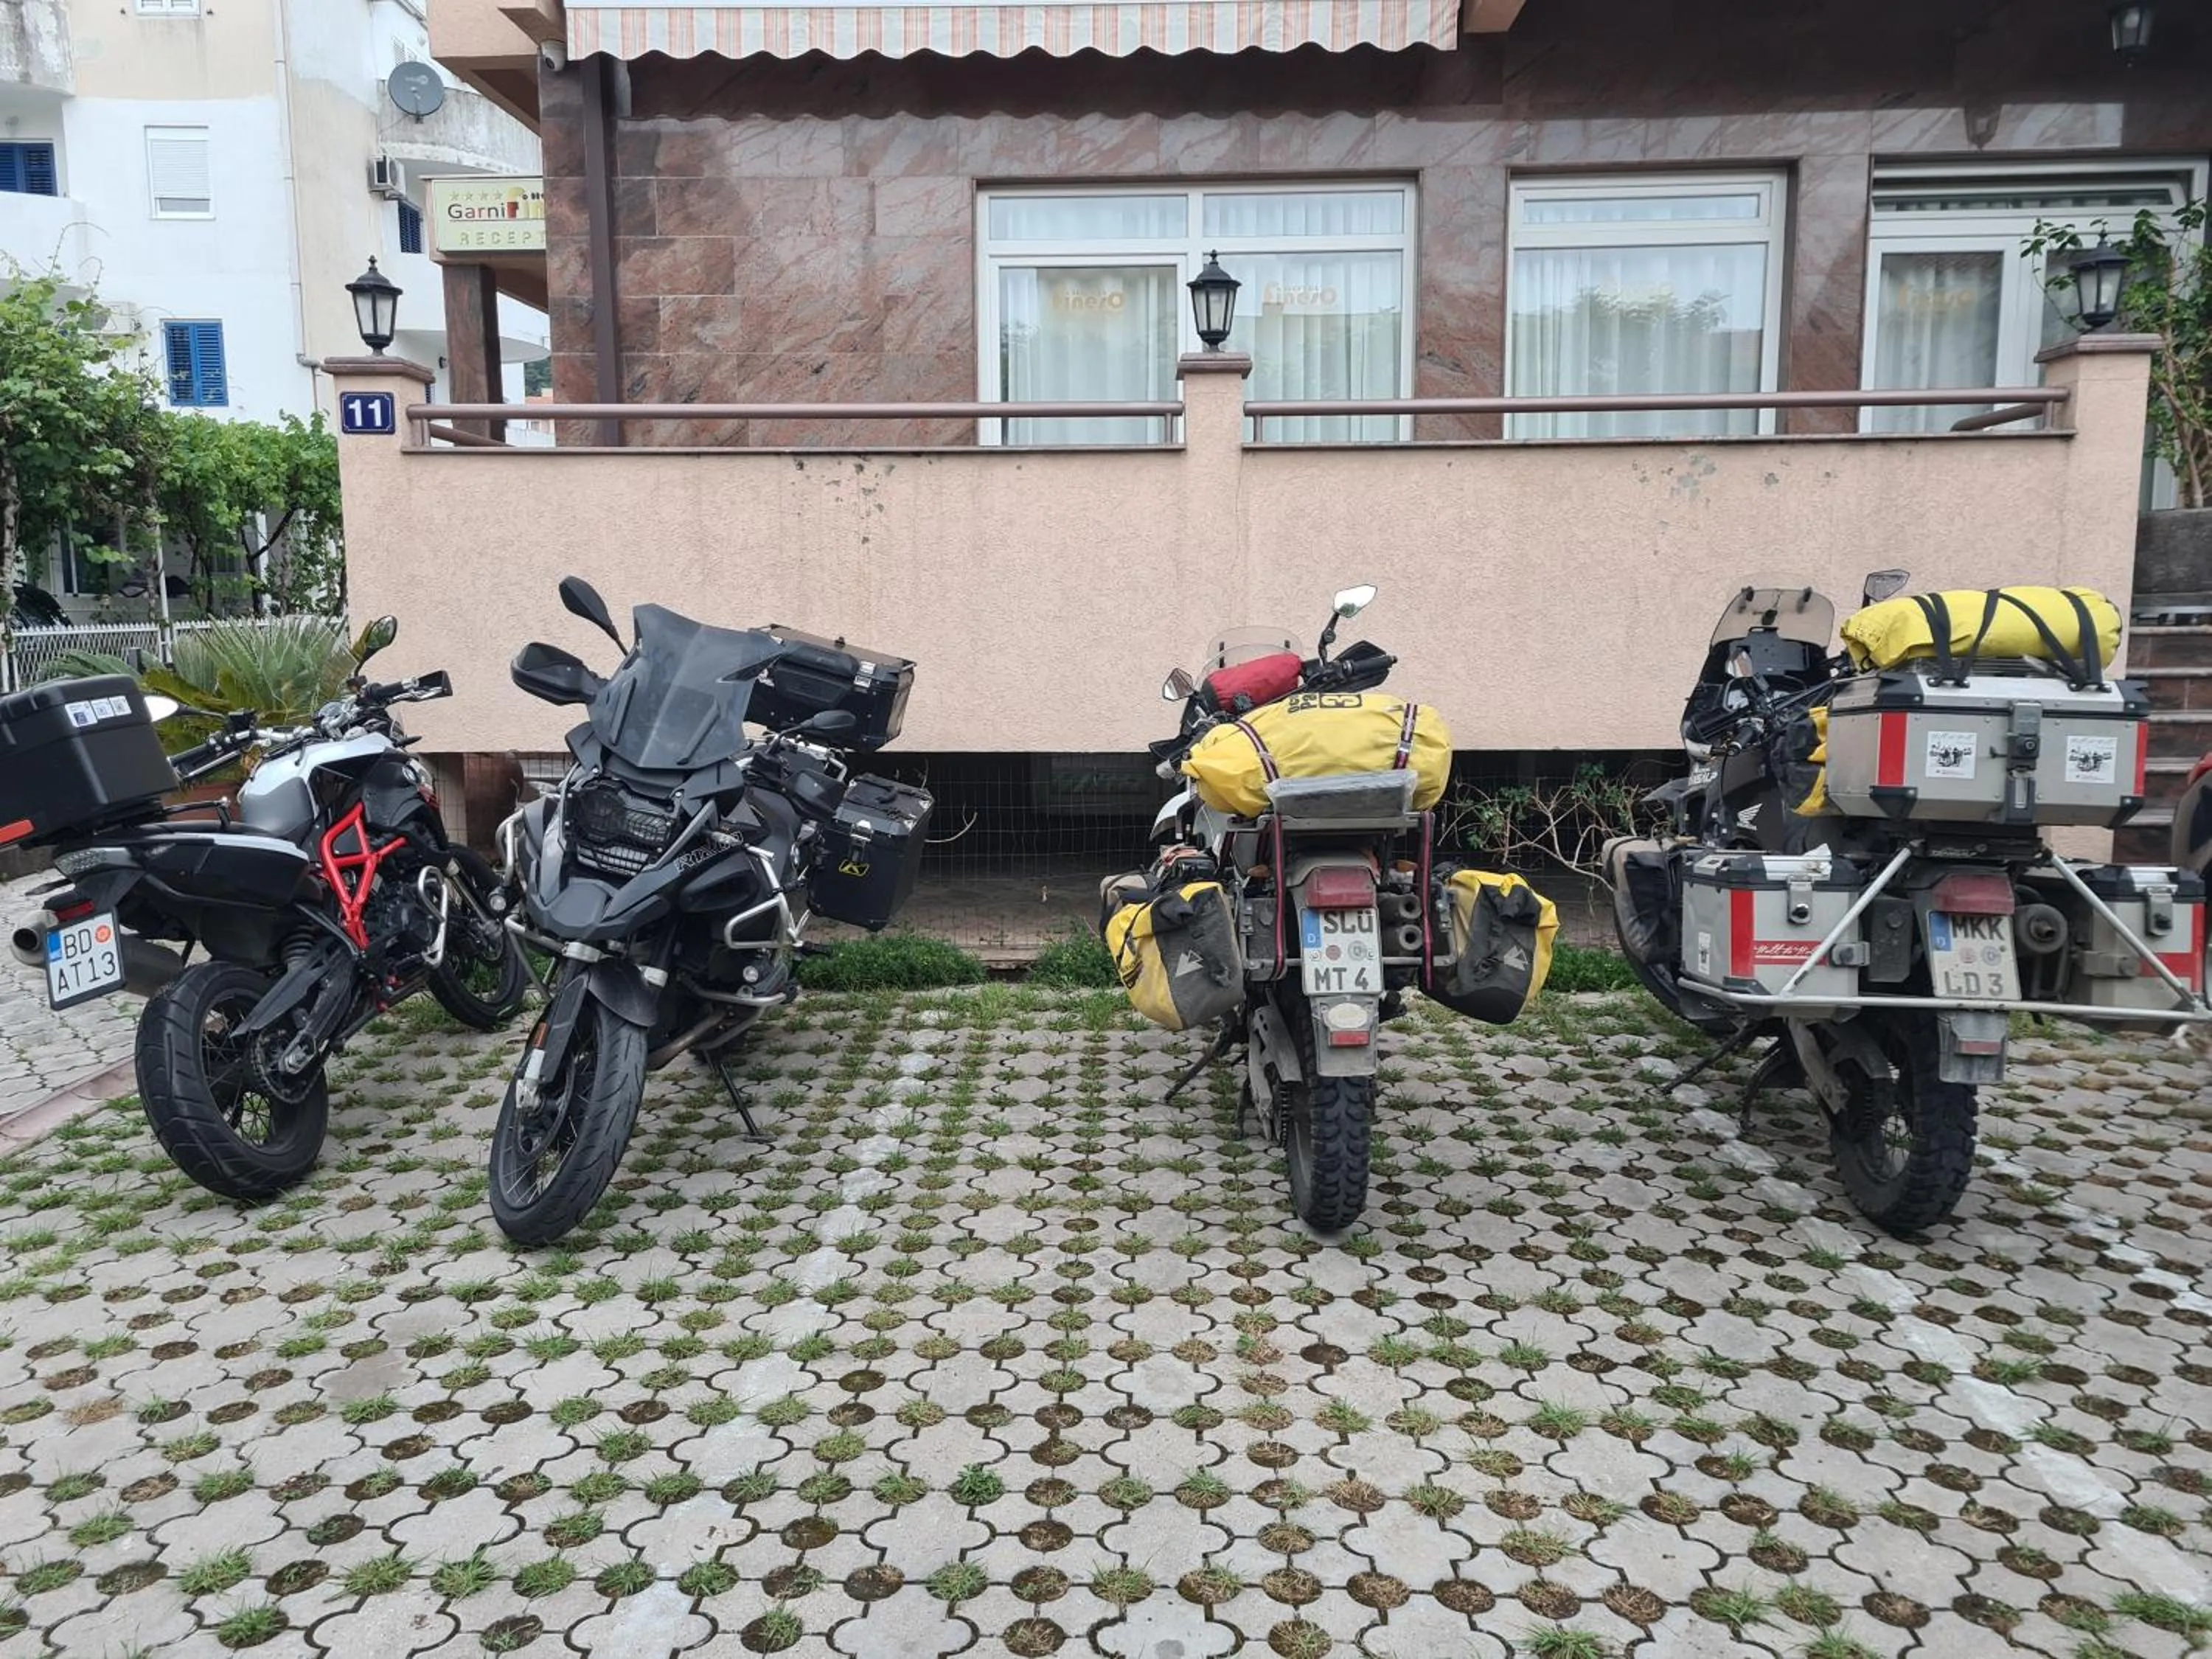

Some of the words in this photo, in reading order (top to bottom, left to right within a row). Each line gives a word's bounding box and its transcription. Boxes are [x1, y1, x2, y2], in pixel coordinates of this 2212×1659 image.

[448, 202, 505, 219] Garni
[349, 399, 382, 426] 11
[1951, 916, 2006, 940] MKK
[63, 928, 92, 959] BD
[1315, 967, 1347, 991] MT
[1354, 967, 1369, 990] 4
[1944, 971, 1981, 995] LD
[1988, 973, 2004, 996] 3
